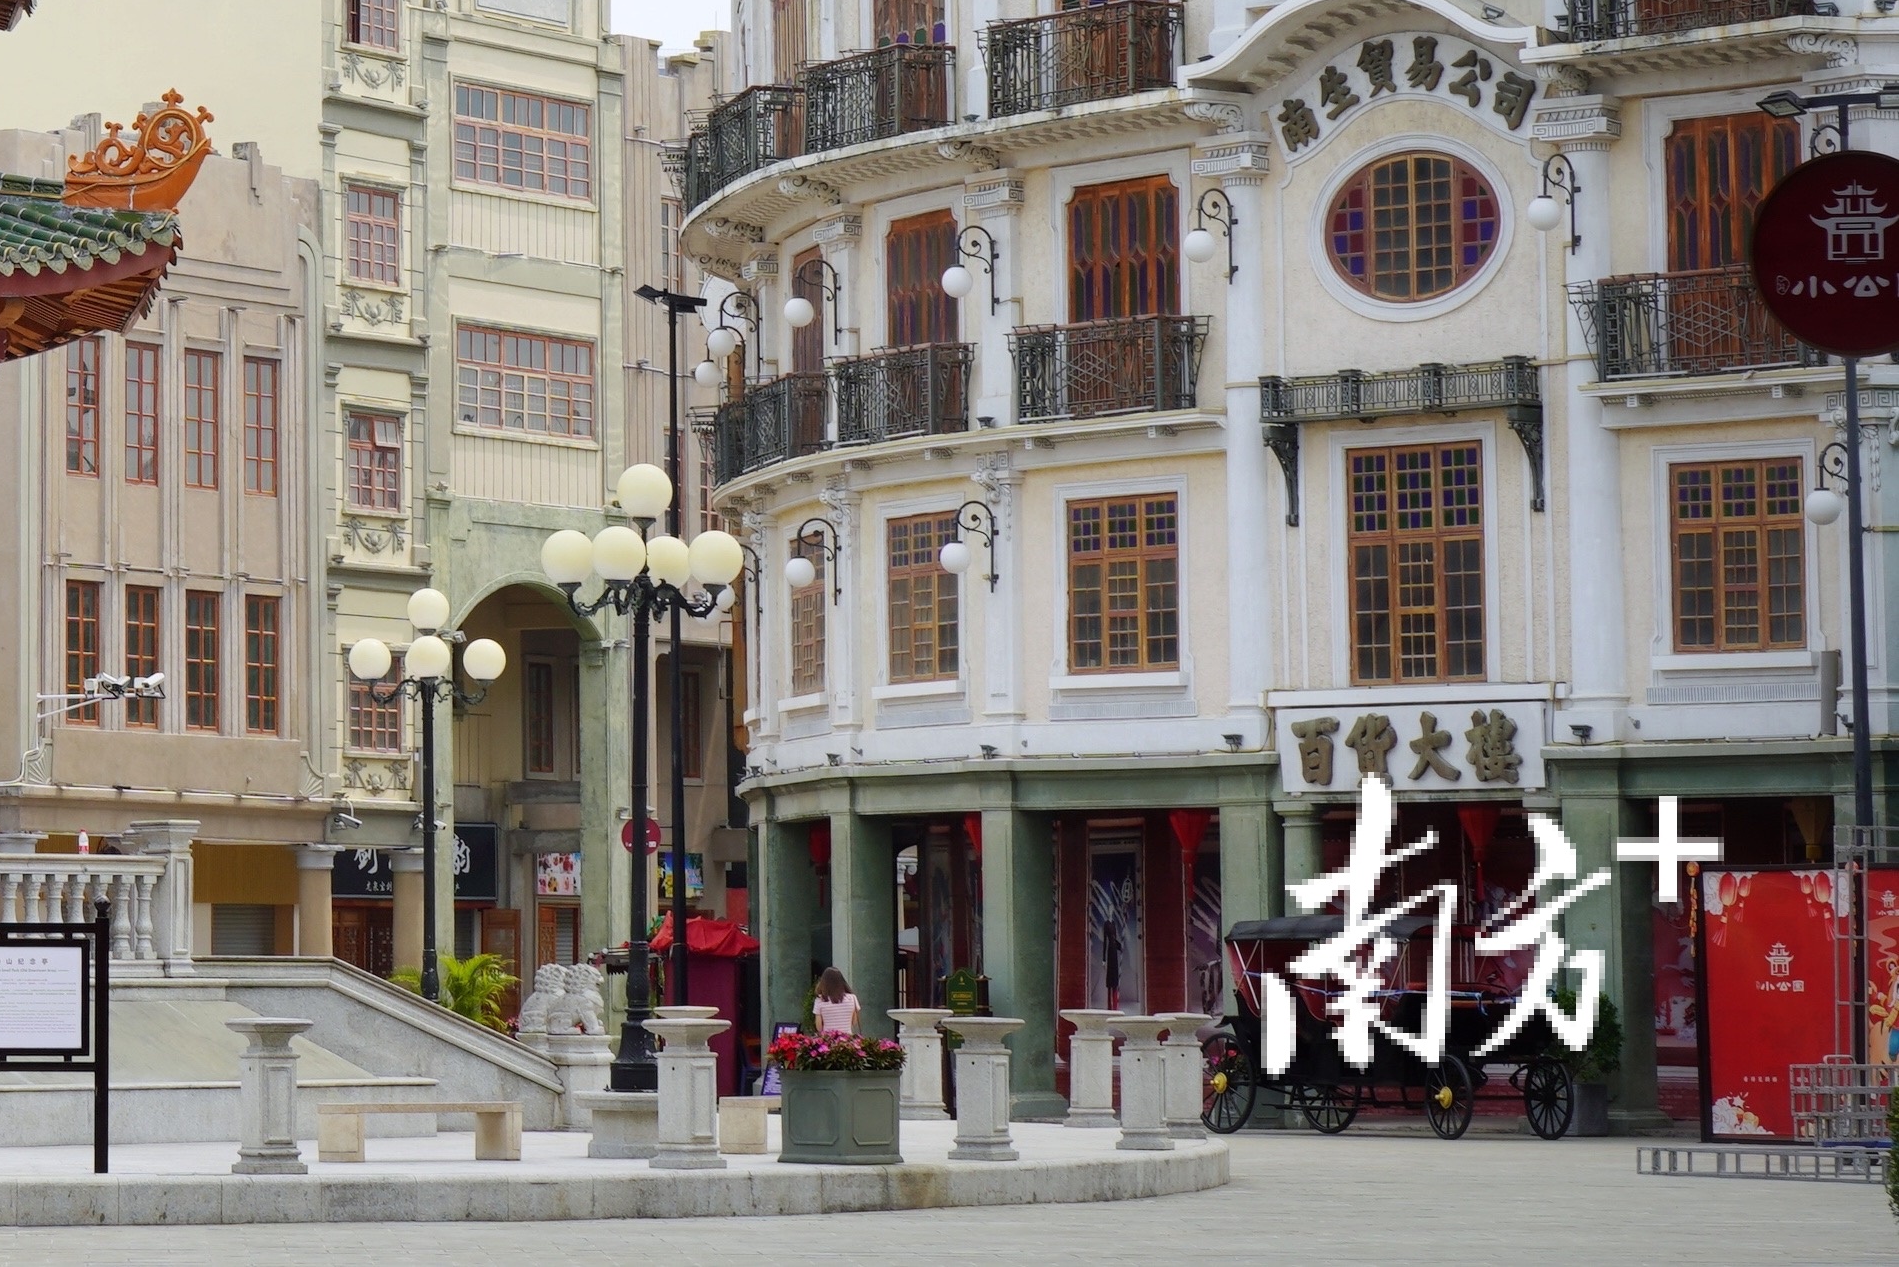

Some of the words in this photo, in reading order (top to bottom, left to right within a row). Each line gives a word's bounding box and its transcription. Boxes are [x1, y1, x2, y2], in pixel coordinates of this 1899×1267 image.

[1278, 36, 1536, 152] 南生貿易公司
[1791, 275, 1899, 299] 小公
